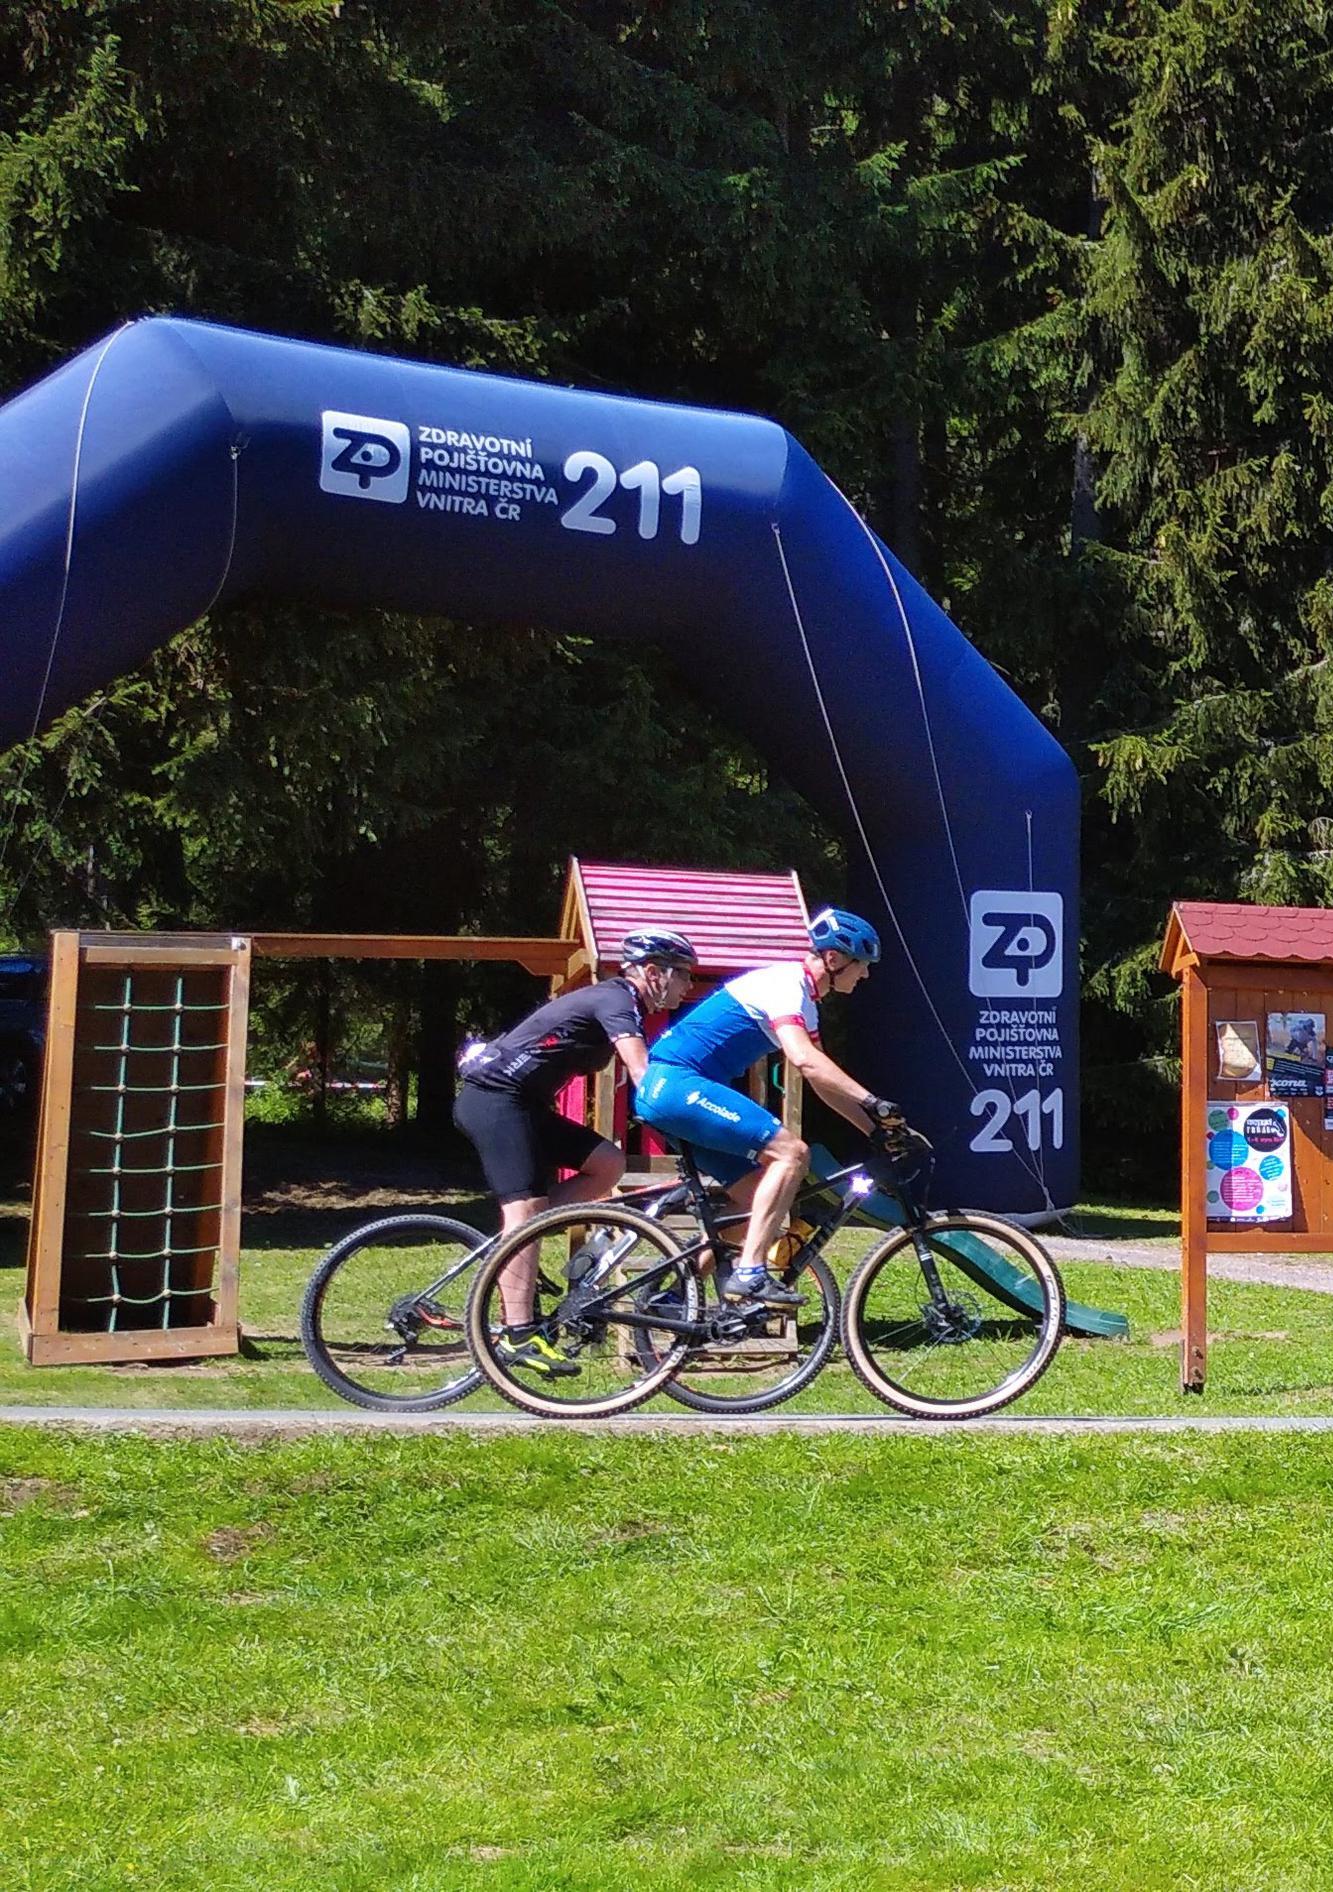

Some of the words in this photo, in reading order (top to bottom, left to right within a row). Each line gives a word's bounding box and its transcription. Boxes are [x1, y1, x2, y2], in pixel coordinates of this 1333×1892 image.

[418, 426, 533, 458] ZDRAVOTNÍ
[420, 447, 545, 481] POJIŠŤOVNA
[418, 469, 559, 505] MINISTERSTVA
[560, 451, 701, 545] 211
[417, 490, 489, 518] VNITRA
[495, 499, 521, 521] ČR
[979, 1006, 1057, 1025] ZDRAVOTNÍ
[975, 1023, 1059, 1042] POJIŠŤOVNA
[969, 1045, 1062, 1060] MINISTERSTVA
[983, 1063, 1036, 1077] VNITRA
[1038, 1059, 1054, 1076] ČR
[696, 1097, 742, 1123] Accolade
[969, 1087, 1063, 1152] 211
